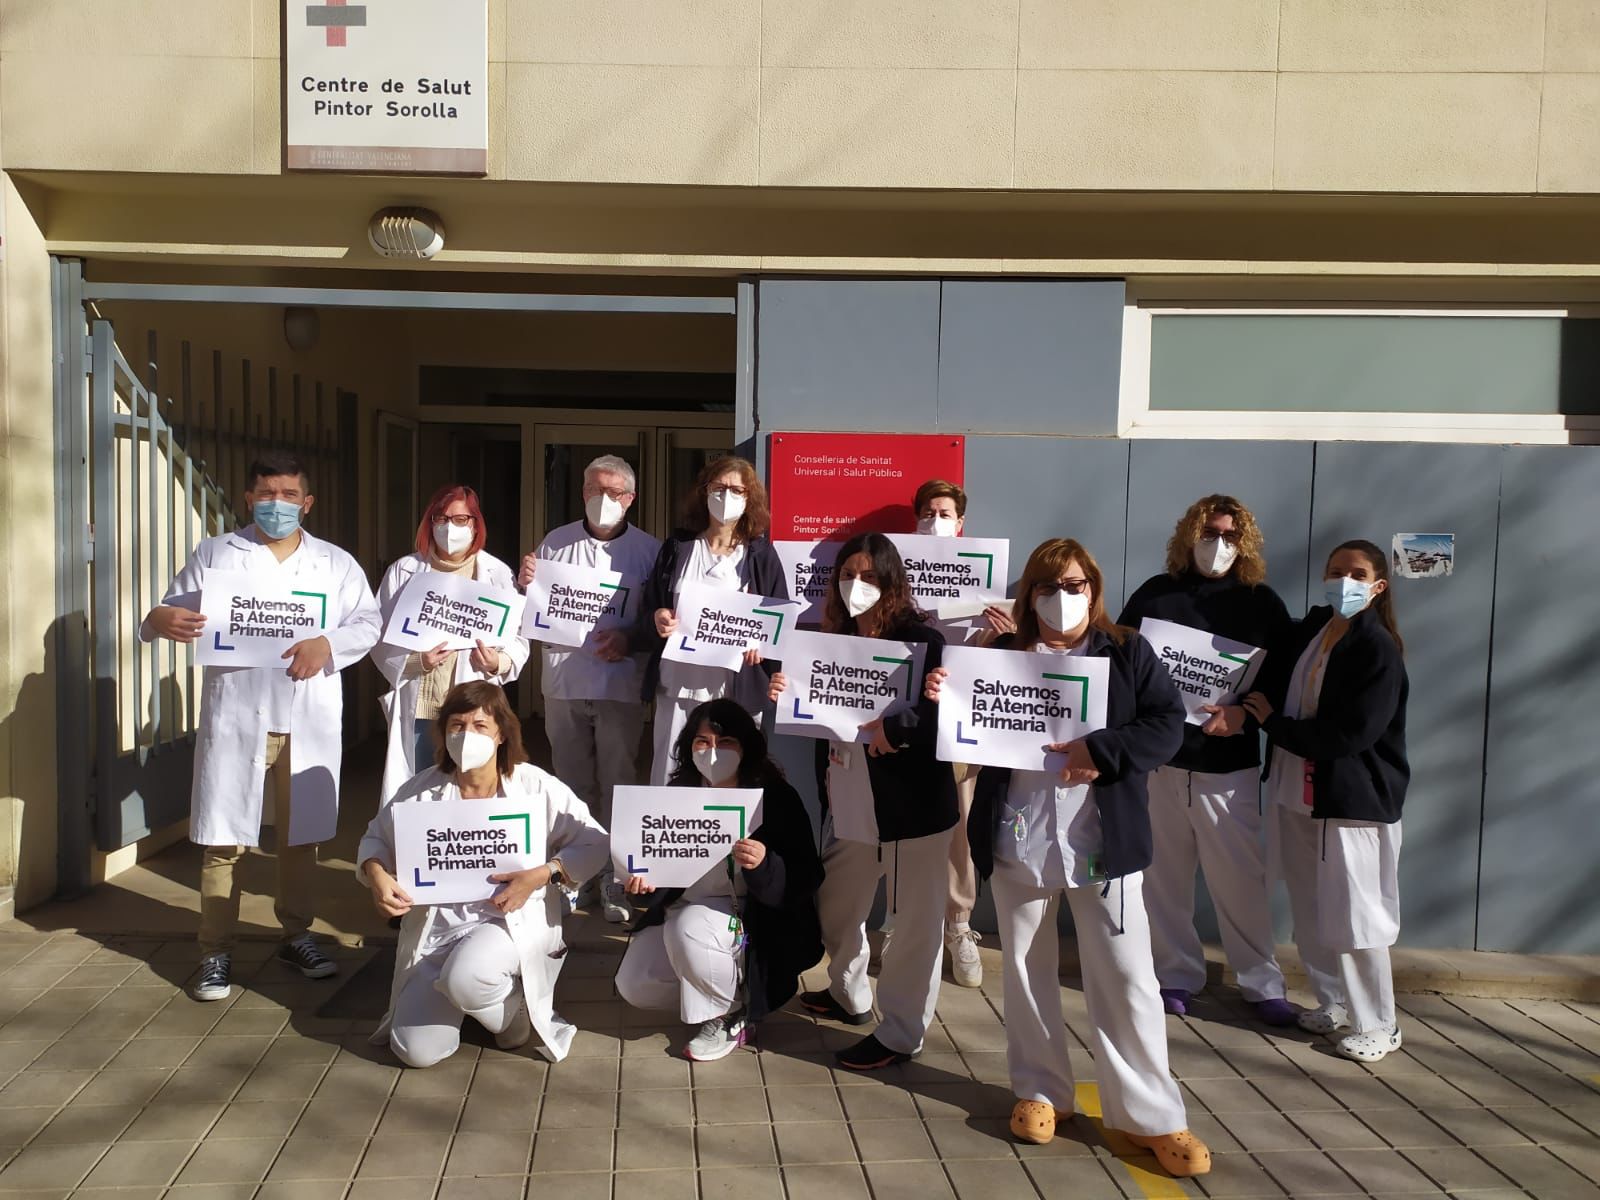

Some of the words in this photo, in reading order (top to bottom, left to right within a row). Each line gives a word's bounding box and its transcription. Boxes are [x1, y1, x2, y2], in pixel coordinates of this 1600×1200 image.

[301, 76, 369, 93] Centre
[381, 78, 405, 93] de
[417, 78, 472, 95] Salut
[314, 100, 373, 116] Pintor
[386, 101, 458, 118] Sorolla
[794, 454, 844, 464] Conselleria
[846, 455, 858, 464] de
[860, 455, 892, 465] Sanitat
[794, 467, 836, 476] Universal
[843, 468, 866, 477] Salut
[869, 468, 903, 478] Pública
[793, 515, 821, 523] Centre
[823, 515, 834, 523] de
[835, 516, 856, 524] salut
[793, 525, 819, 534] Pintor
[904, 558, 972, 574] Salvemos
[795, 574, 806, 586] la
[907, 573, 915, 583] a
[918, 572, 980, 587] Atención
[550, 583, 611, 603] Salvemos
[911, 583, 960, 598] rimaria
[231, 595, 306, 613] Salvemos
[425, 590, 488, 619] Salvemos
[548, 594, 559, 606] la
[561, 597, 616, 615] Atención
[230, 609, 244, 623] la
[247, 611, 315, 627] Atención
[421, 601, 433, 614] la
[435, 606, 493, 633] Atención
[547, 606, 599, 624] Primaria
[700, 607, 763, 630] Salvemos
[229, 622, 294, 639] Primaria
[417, 613, 472, 639] Primaria
[697, 619, 709, 631] la
[711, 622, 769, 642] Atención
[695, 631, 748, 648] Primaria
[1161, 645, 1230, 677] Salvemos
[811, 659, 889, 682] Salvemos
[1171, 663, 1232, 691] Atención
[810, 674, 824, 689] la
[827, 677, 898, 698] Atención
[973, 678, 1061, 702] Salvemos
[808, 689, 875, 711] Primaria
[972, 695, 987, 711] la
[990, 697, 1072, 719] Atención
[971, 712, 1046, 733] Primaria
[642, 814, 721, 830] Salvemos
[426, 828, 507, 843] Salvemos
[641, 830, 655, 844] la
[658, 830, 732, 844] Atención
[427, 843, 442, 857] la
[444, 840, 518, 857] Atención
[641, 845, 710, 859] Primaria
[428, 856, 497, 871] Primaria
